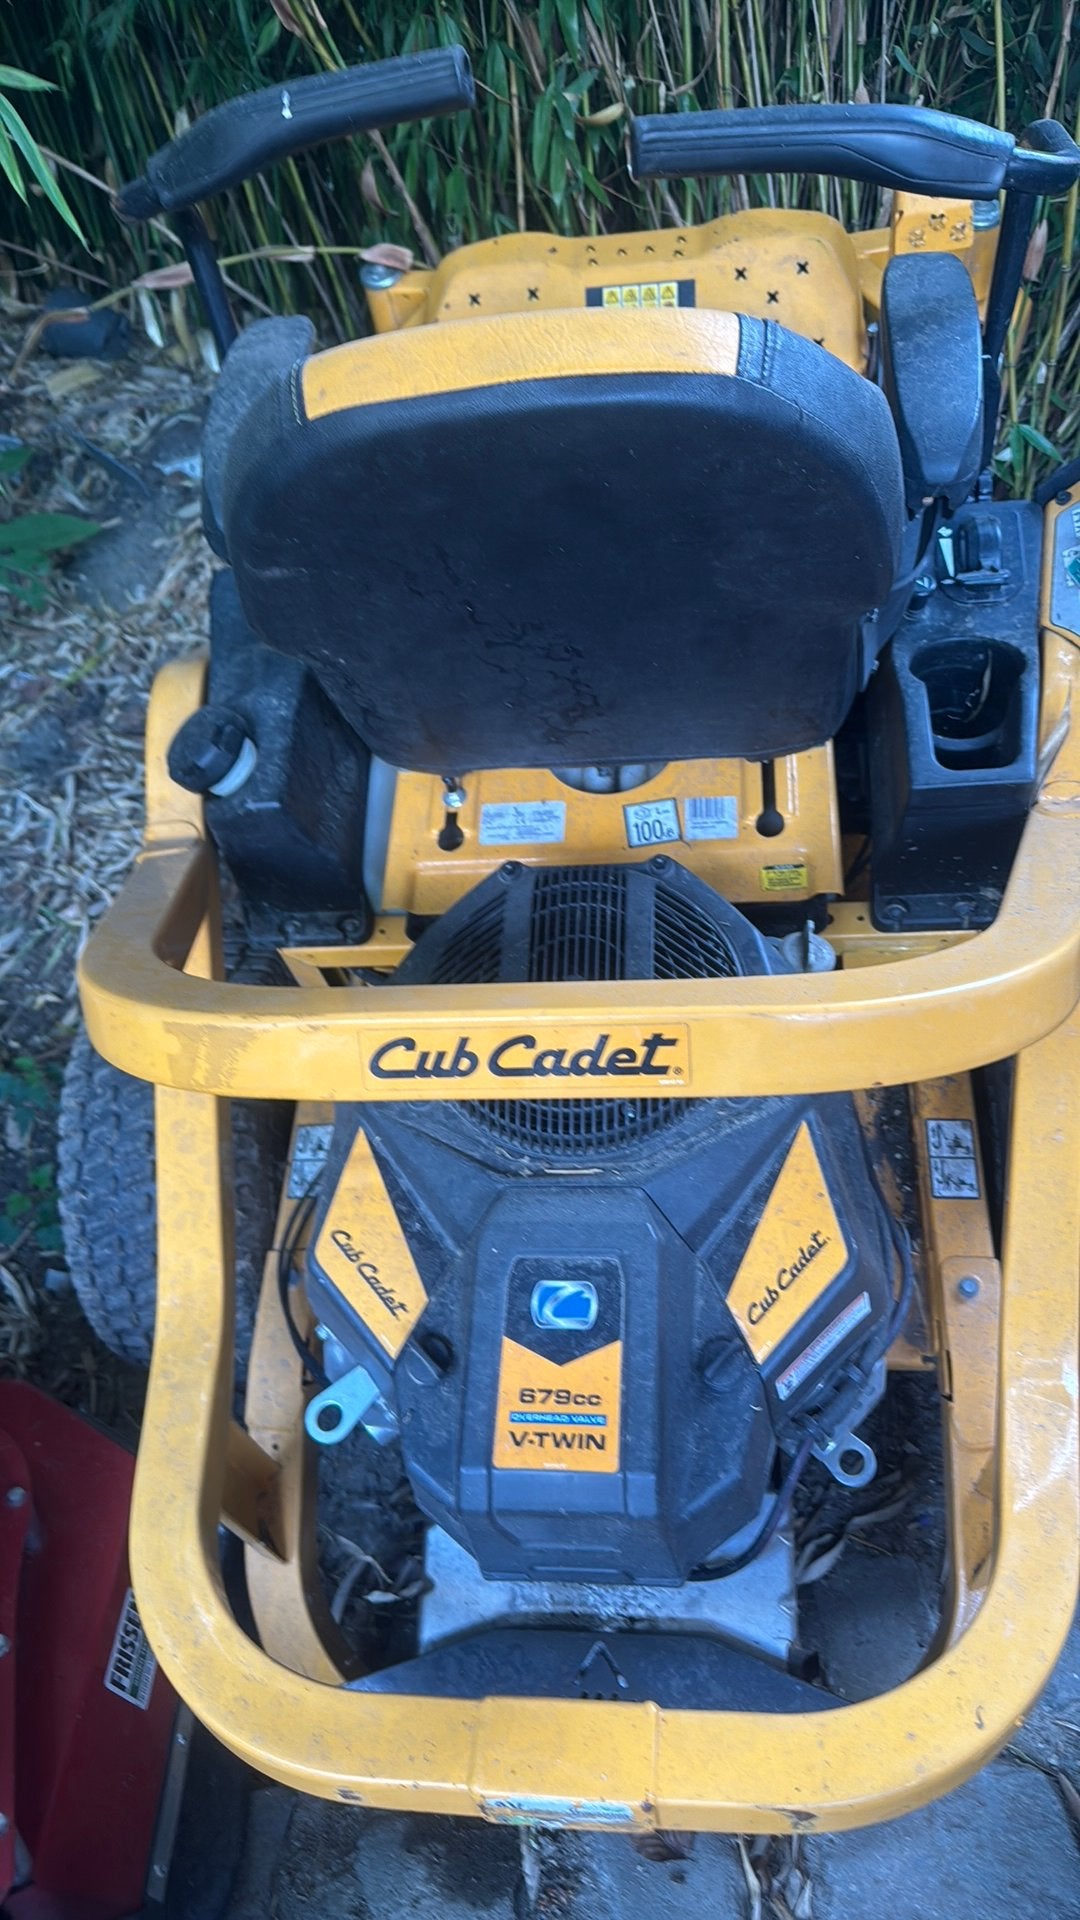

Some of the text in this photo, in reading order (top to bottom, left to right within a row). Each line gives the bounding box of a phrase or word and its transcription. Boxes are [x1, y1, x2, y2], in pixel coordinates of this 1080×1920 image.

[632, 820, 664, 842] 100
[368, 1036, 479, 1079] Cub
[331, 1229, 410, 1319] Cub Cadet
[747, 1286, 780, 1326] Cub
[519, 1387, 602, 1407] 679cc
[510, 1412, 606, 1425] OVERHEAD VALVE
[508, 1430, 606, 1451] V-TWIN
